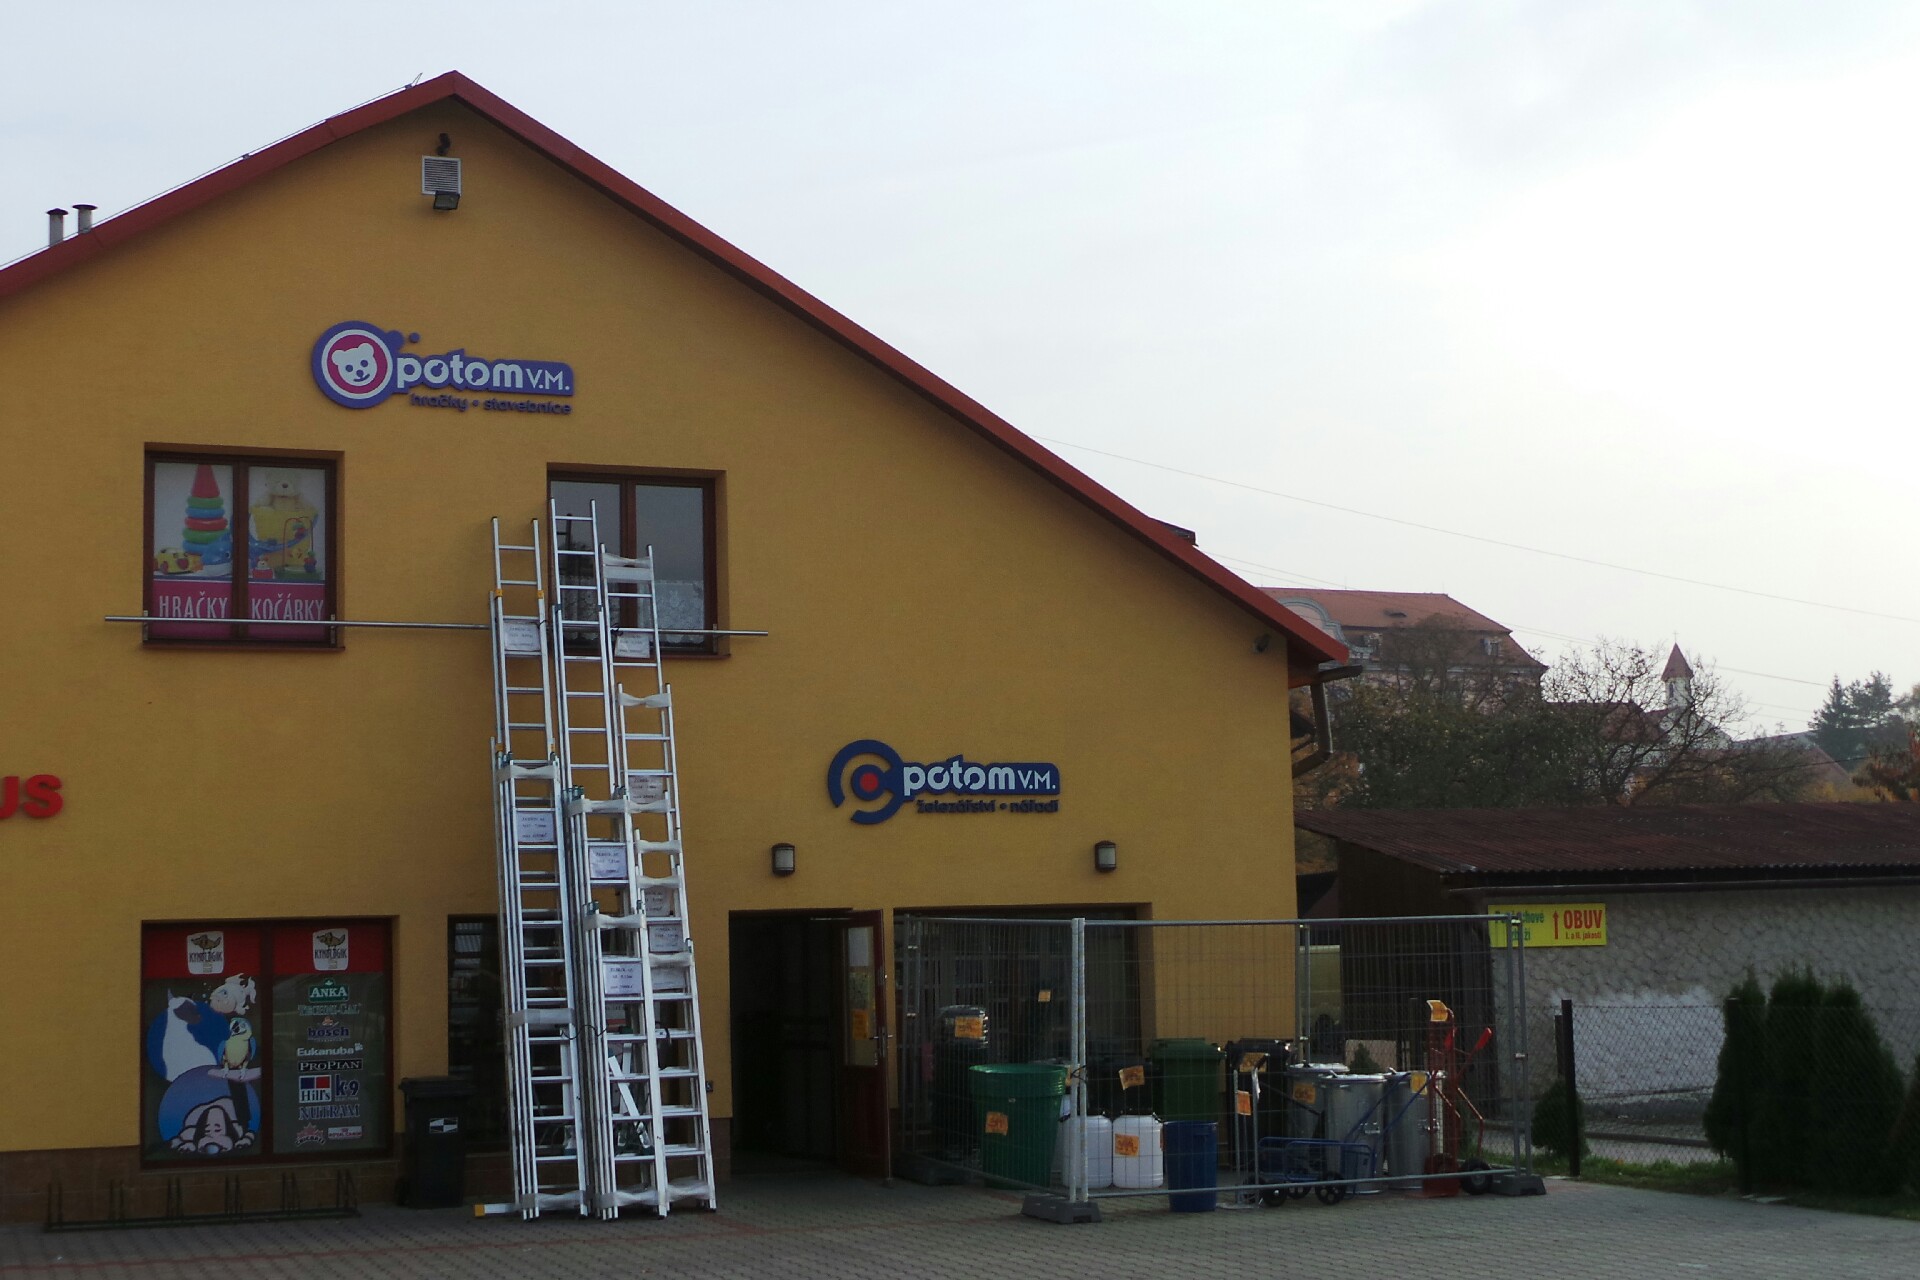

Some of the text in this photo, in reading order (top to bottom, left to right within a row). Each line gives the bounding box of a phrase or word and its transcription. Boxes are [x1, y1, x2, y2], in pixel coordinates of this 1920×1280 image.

[397, 354, 523, 389] potom
[409, 392, 572, 415] hračky stavebnice
[158, 591, 228, 618] HRAČKY
[251, 593, 324, 621] KOČÁRKY
[903, 760, 1015, 796] potom
[916, 799, 1059, 813] železářství nářadí
[1563, 909, 1602, 929] OBUV
[309, 986, 348, 998] ANKA
[308, 1026, 349, 1038] bosch
[297, 1046, 354, 1057] Eukanuba
[301, 1089, 331, 1102] Hill's
